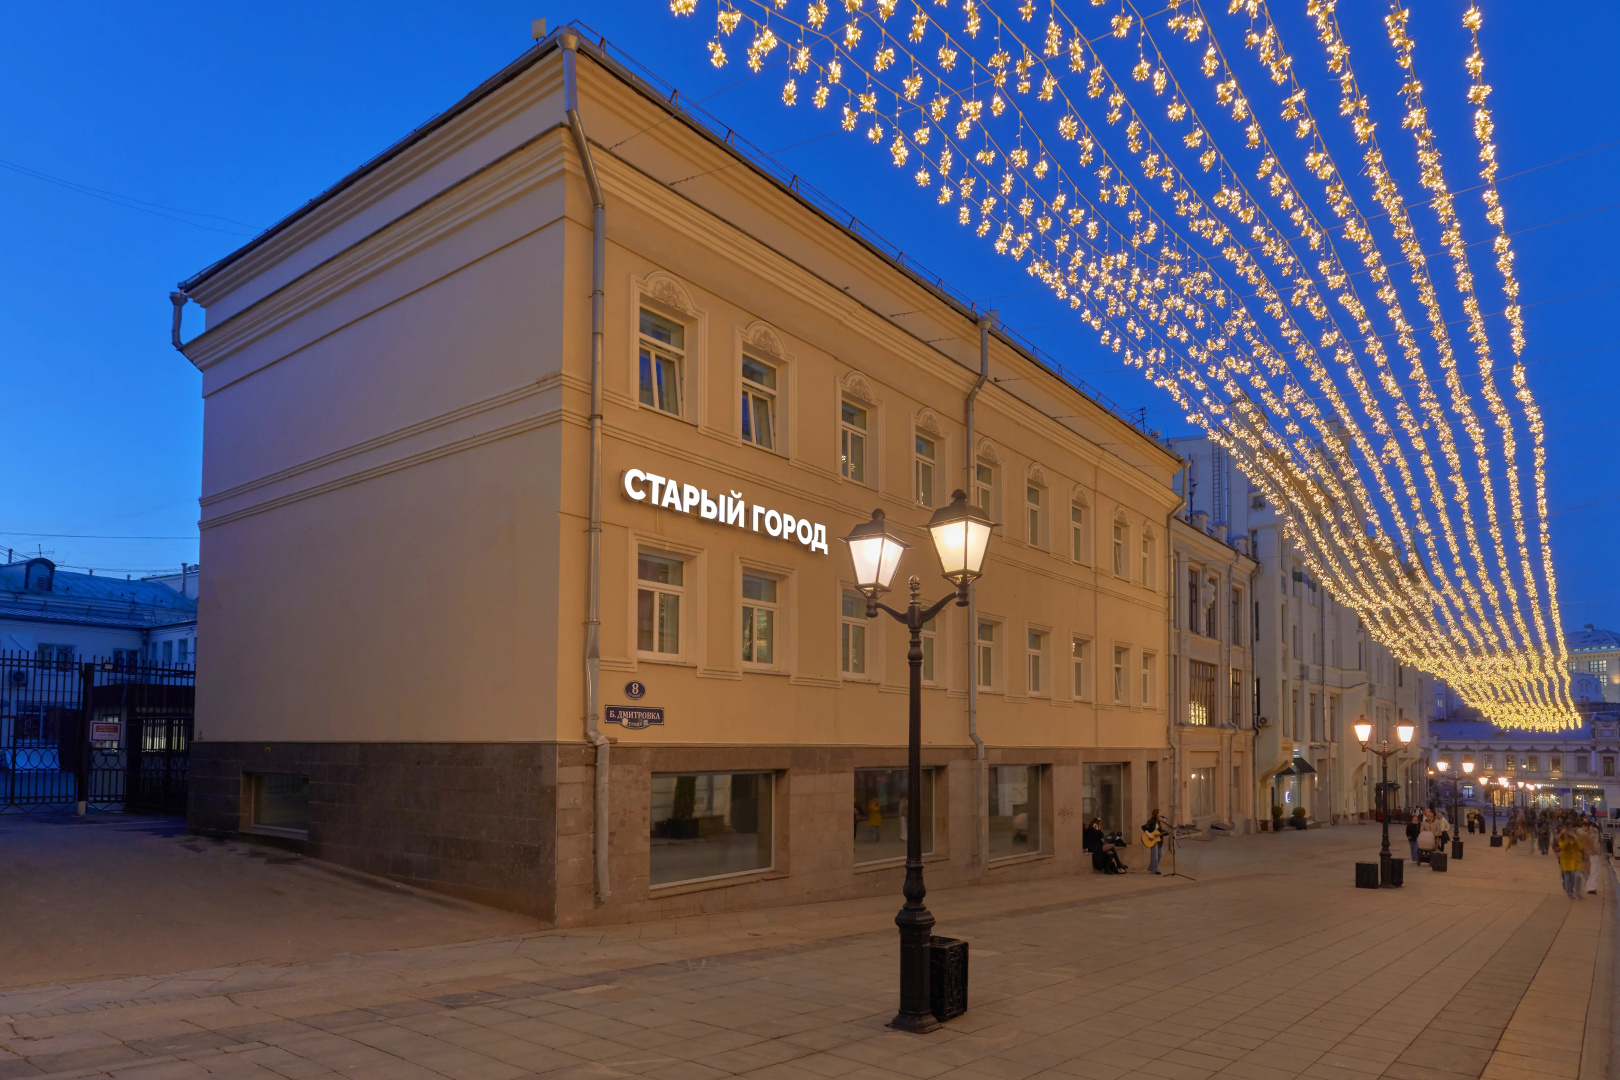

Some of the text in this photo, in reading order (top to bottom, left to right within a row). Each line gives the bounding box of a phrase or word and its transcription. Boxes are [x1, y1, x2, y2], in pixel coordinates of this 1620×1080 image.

[624, 468, 829, 555] СТАРЫЙ ГОРОД
[632, 682, 639, 695] 8
[609, 710, 661, 720] Б. ДМИТРОВКА
